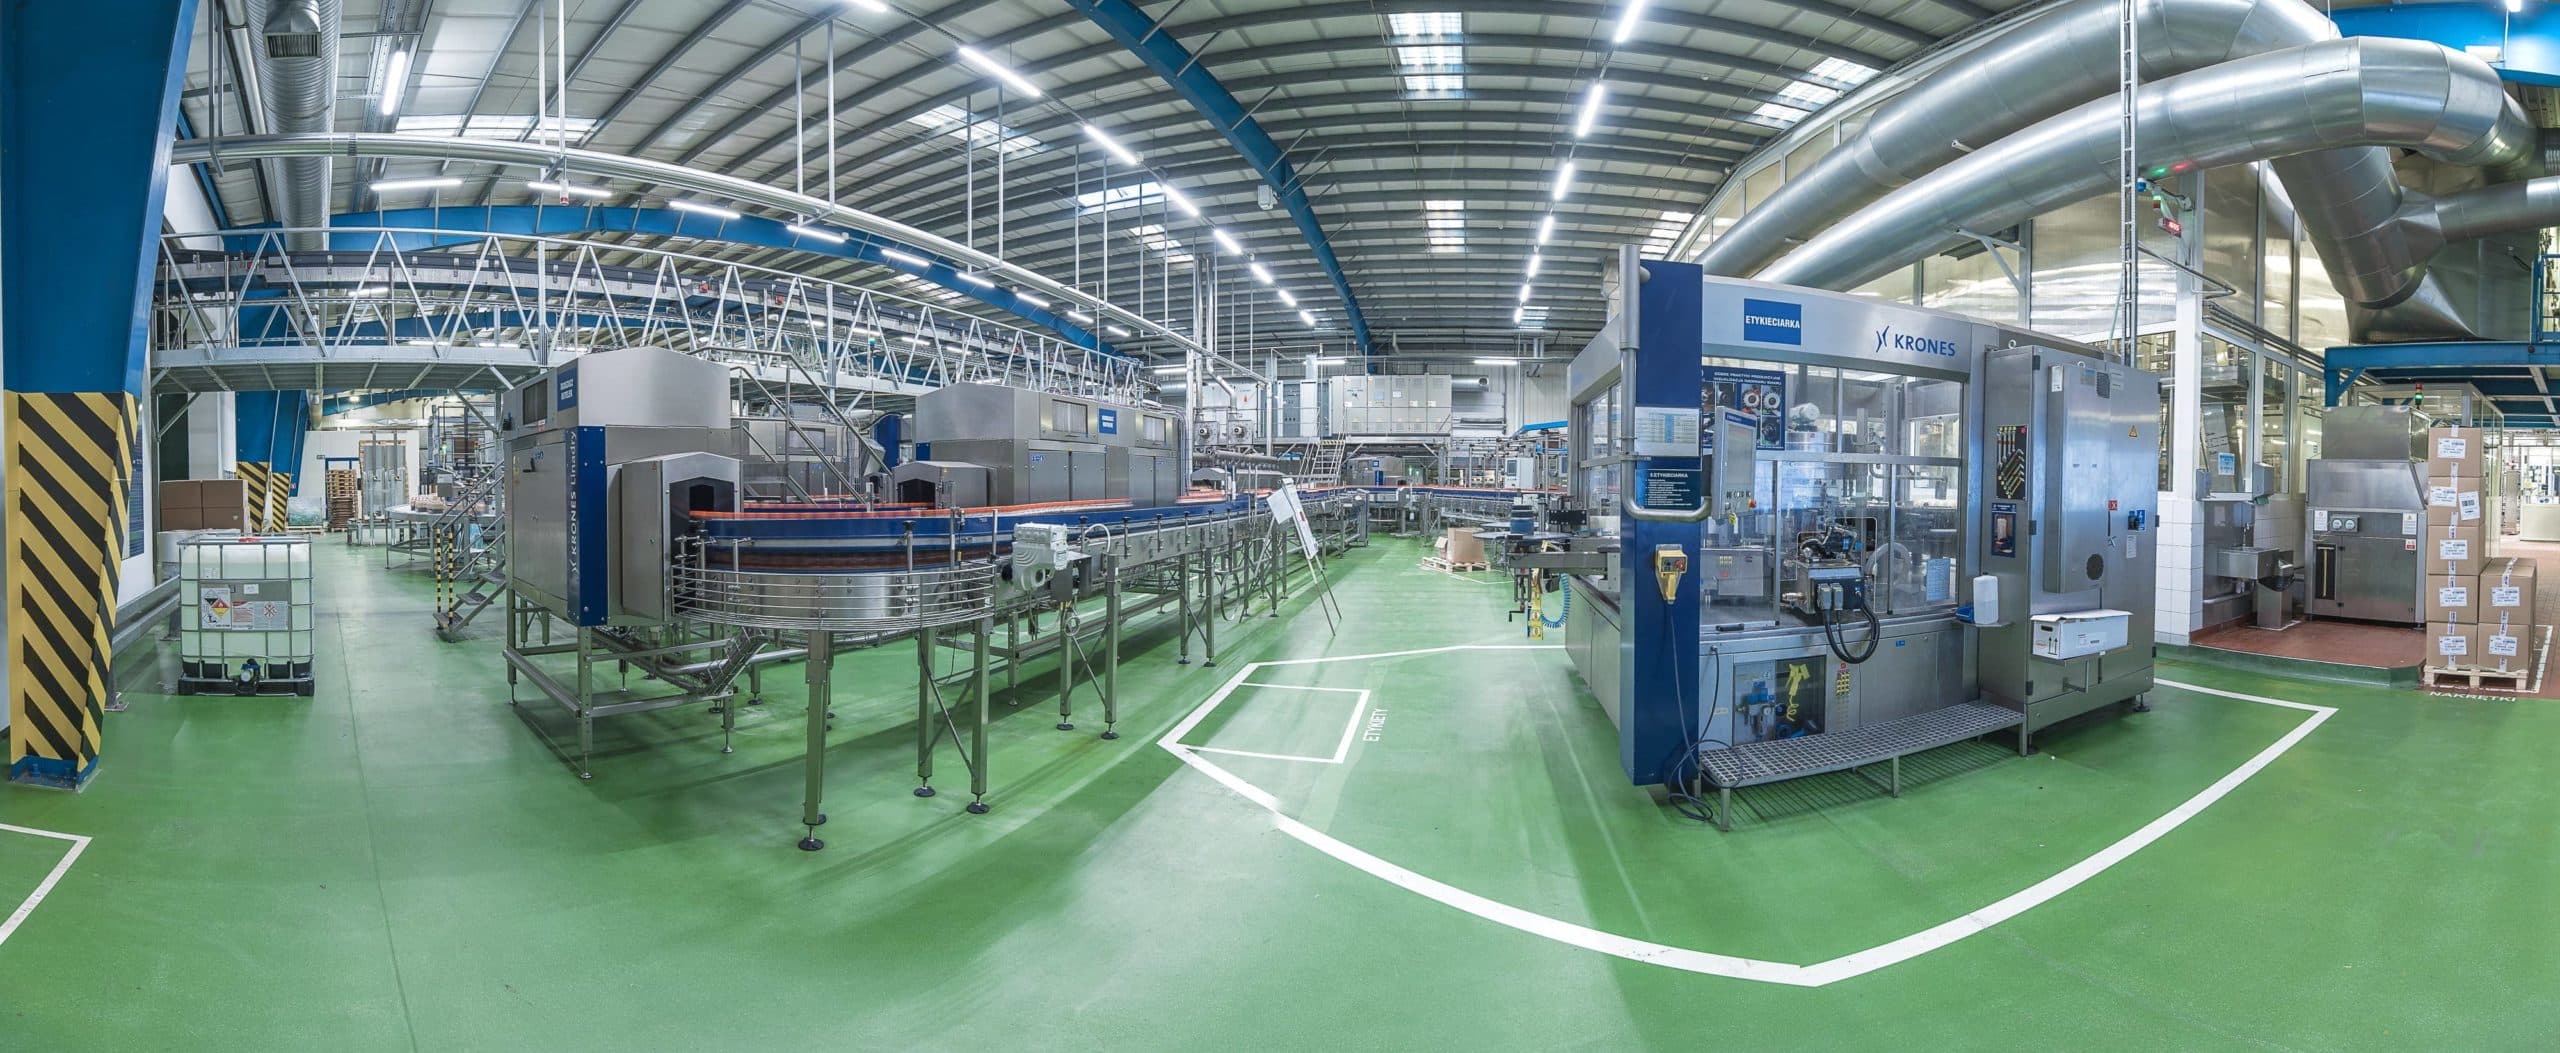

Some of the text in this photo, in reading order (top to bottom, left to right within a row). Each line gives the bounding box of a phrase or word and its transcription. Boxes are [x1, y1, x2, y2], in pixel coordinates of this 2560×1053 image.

[1745, 315, 1800, 329] ETYKIECIARKA
[1894, 333, 1956, 357] KRONES
[1362, 707, 1388, 742] ETYKIETY
